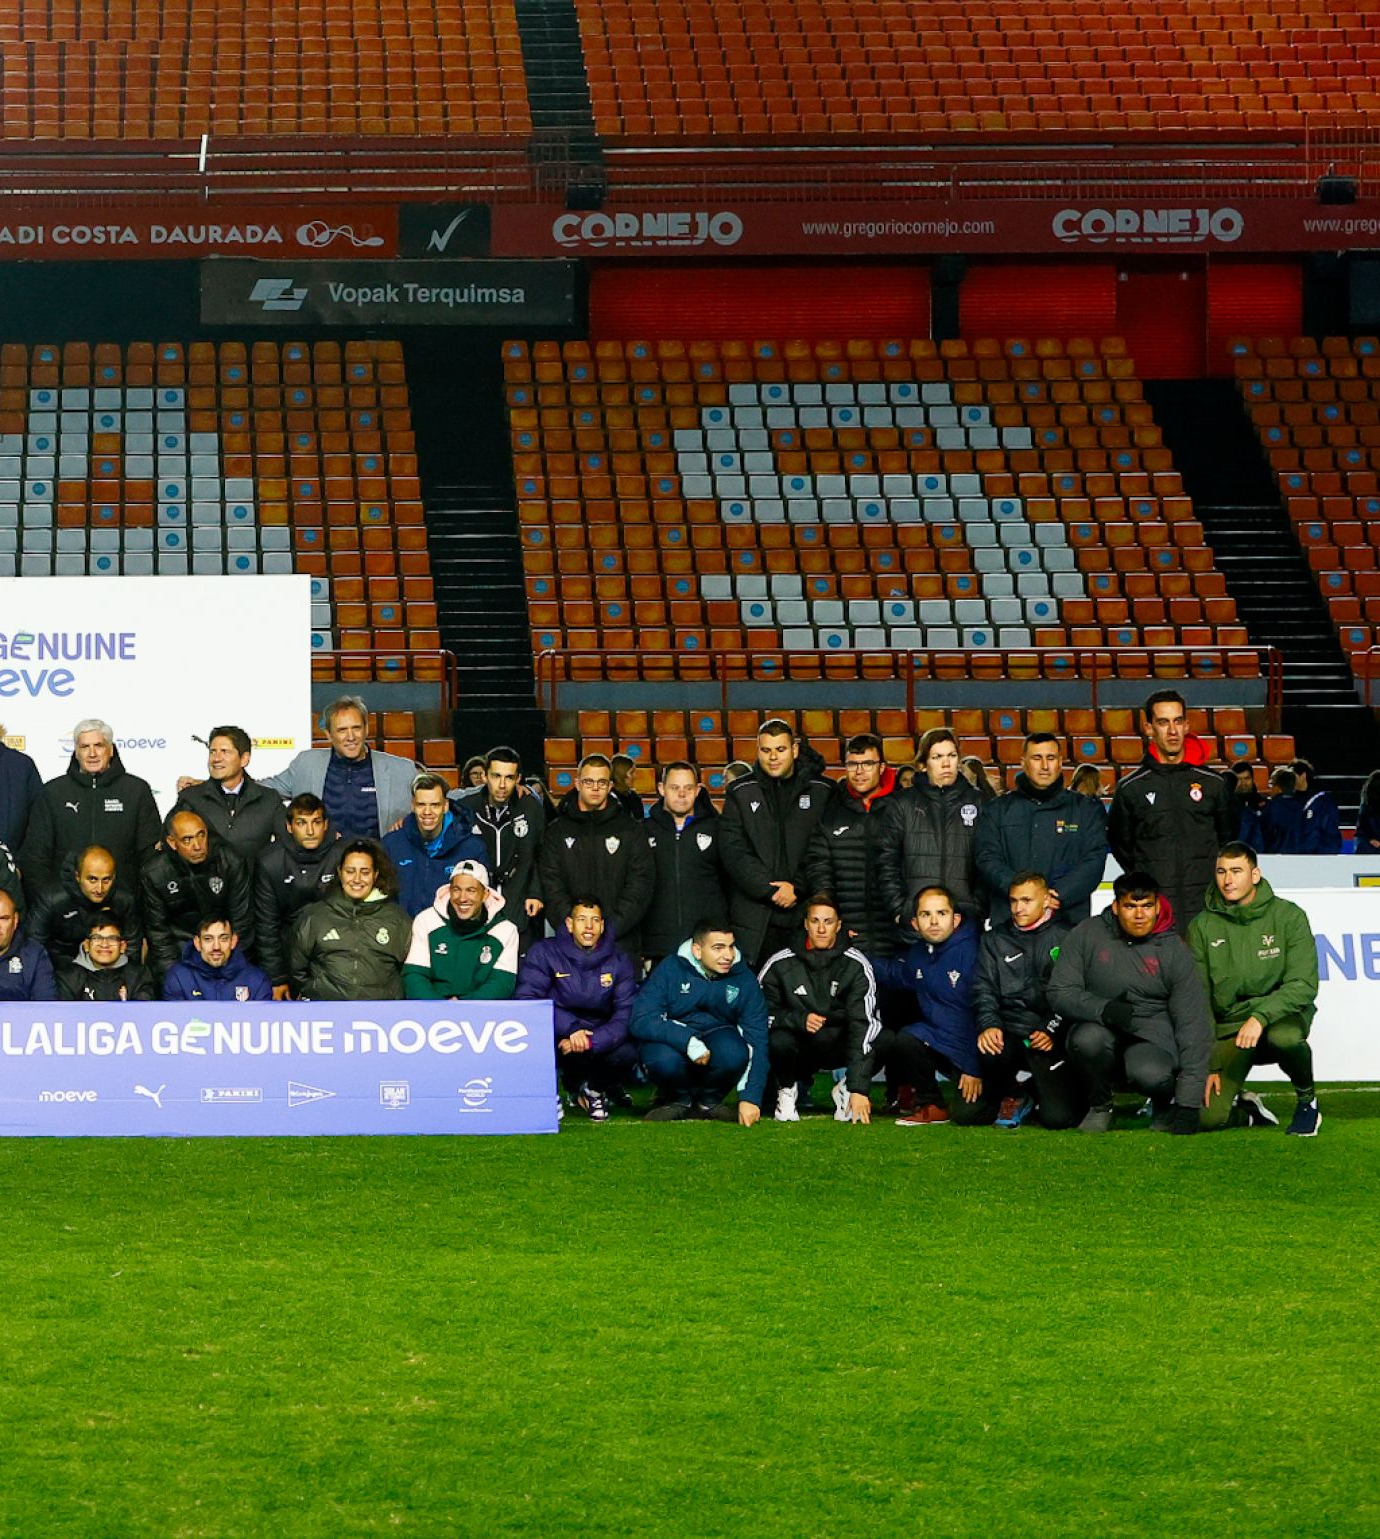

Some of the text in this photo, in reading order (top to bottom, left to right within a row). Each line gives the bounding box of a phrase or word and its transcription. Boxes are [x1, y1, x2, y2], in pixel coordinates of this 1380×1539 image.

[52, 225, 139, 244] COSTA
[151, 225, 283, 244] DAURADA
[552, 212, 743, 248] CORNEJO
[802, 219, 995, 237] www.gregoriocornejo.com
[1051, 208, 1244, 244] CORNEJO
[1303, 218, 1380, 235] www.greg
[329, 283, 525, 308] Vopak Terquimsa
[3, 1019, 528, 1055] LALIGA GENUINE moeve
[39, 1090, 97, 1102] moeve
[219, 1089, 259, 1097] PANINI
